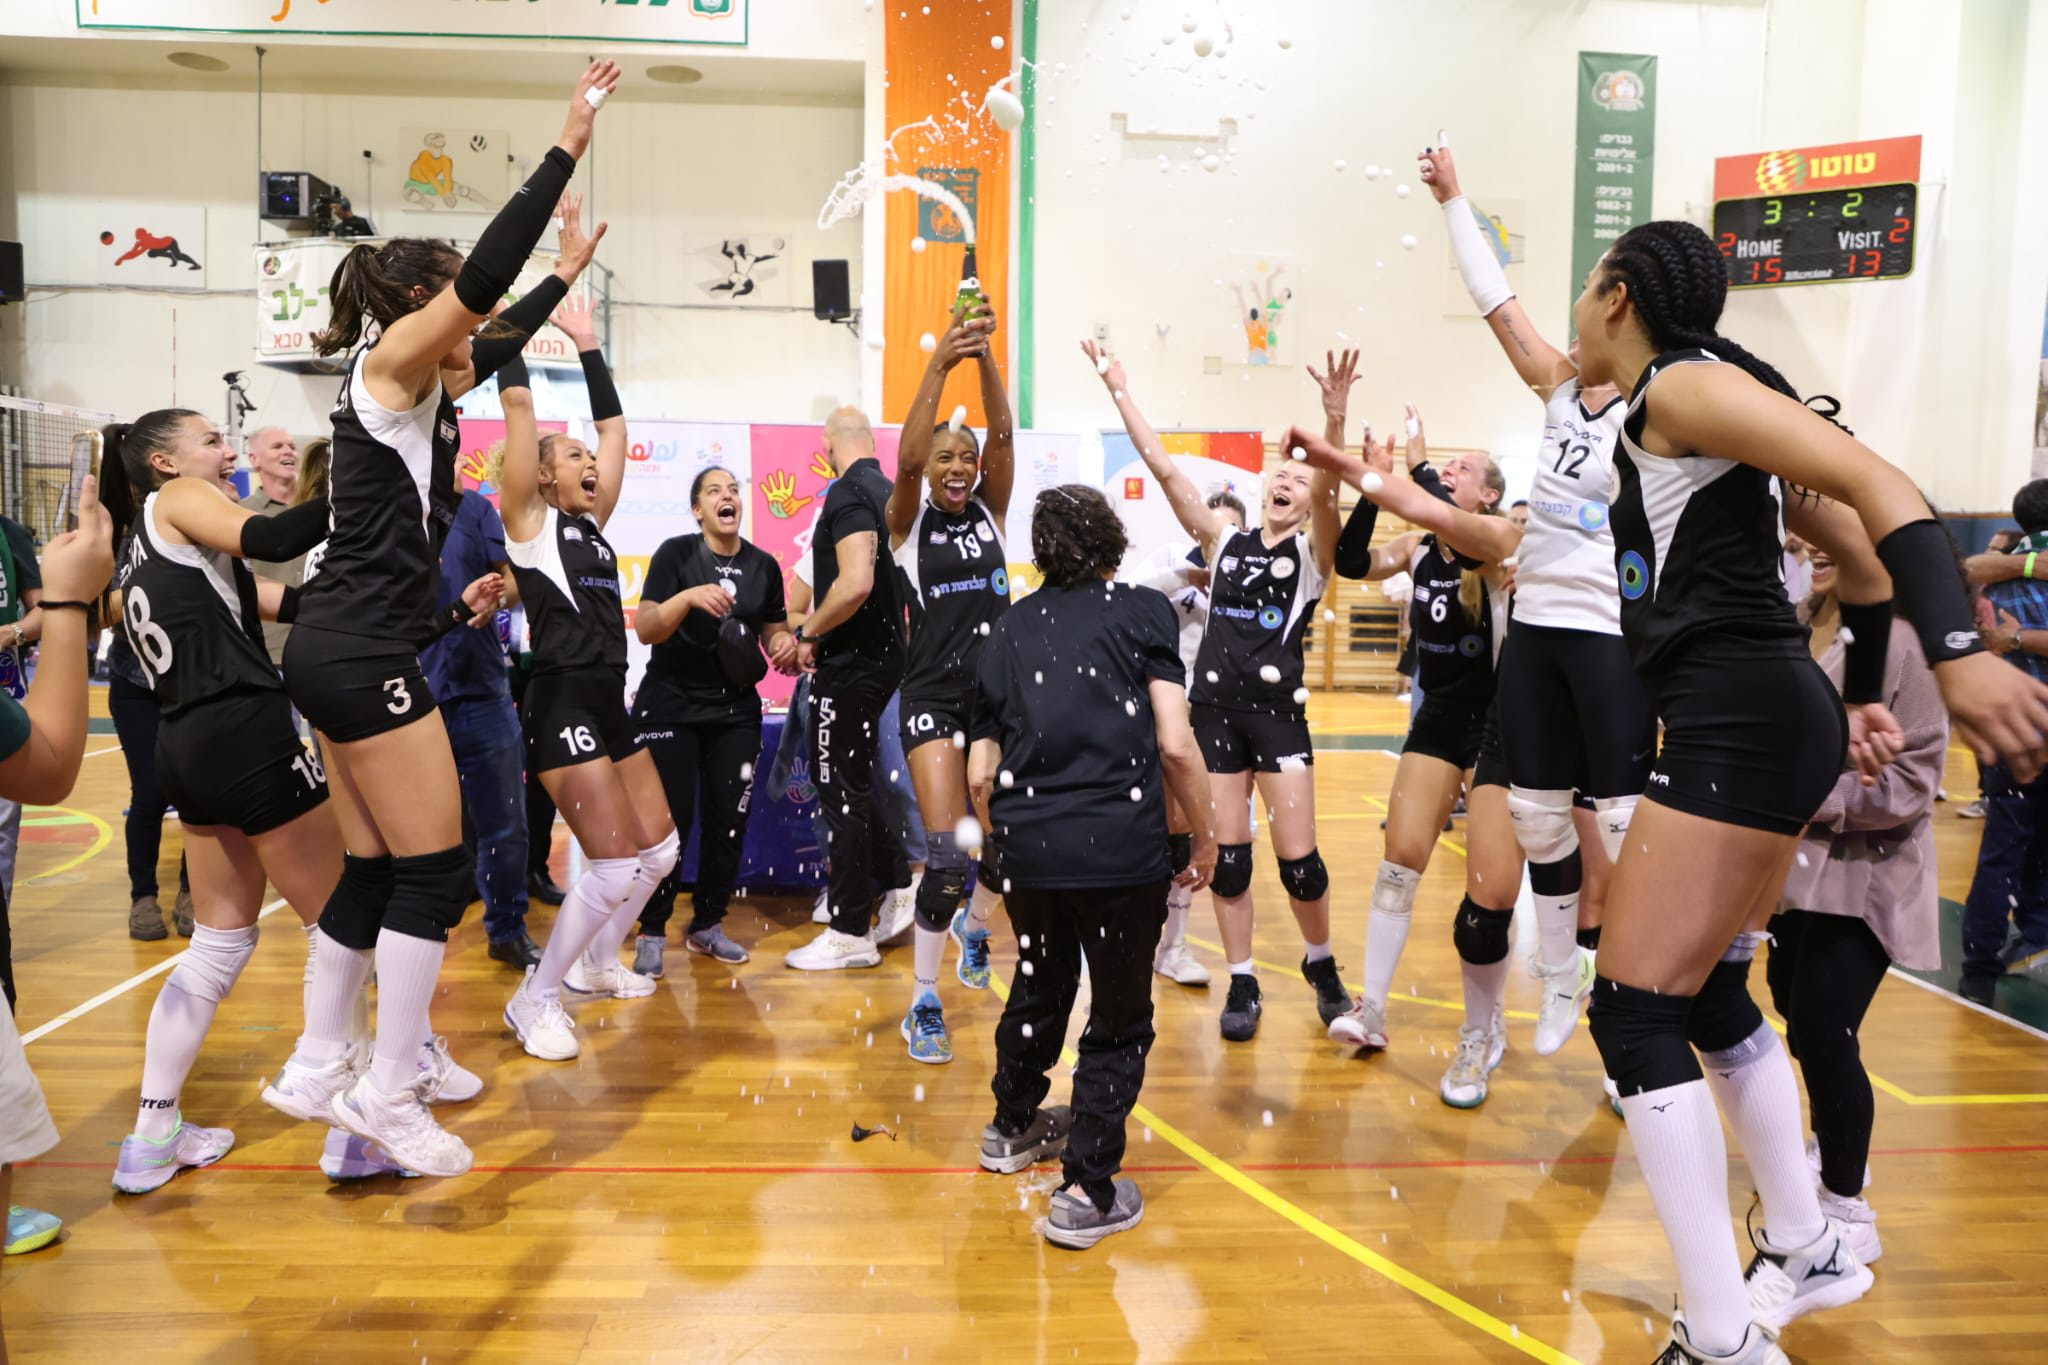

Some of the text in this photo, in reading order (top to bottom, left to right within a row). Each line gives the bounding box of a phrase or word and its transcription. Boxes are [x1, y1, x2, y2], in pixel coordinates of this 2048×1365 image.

[1810, 152, 1876, 179] טוטו
[1764, 200, 1782, 225] 3
[1842, 192, 1863, 217] 2
[1889, 218, 1911, 243] 2
[1737, 239, 1783, 258] HOME
[1752, 258, 1784, 282] 15
[1848, 251, 1882, 275] 13
[1553, 438, 1590, 480] 12
[953, 533, 982, 560] 19
[1242, 566, 1265, 586] 7
[1181, 591, 1197, 614] 4
[1431, 594, 1448, 623] 6
[383, 677, 412, 715] 3
[559, 725, 597, 756] 16
[819, 697, 834, 784] GIVOVA
[291, 752, 327, 790] 18
